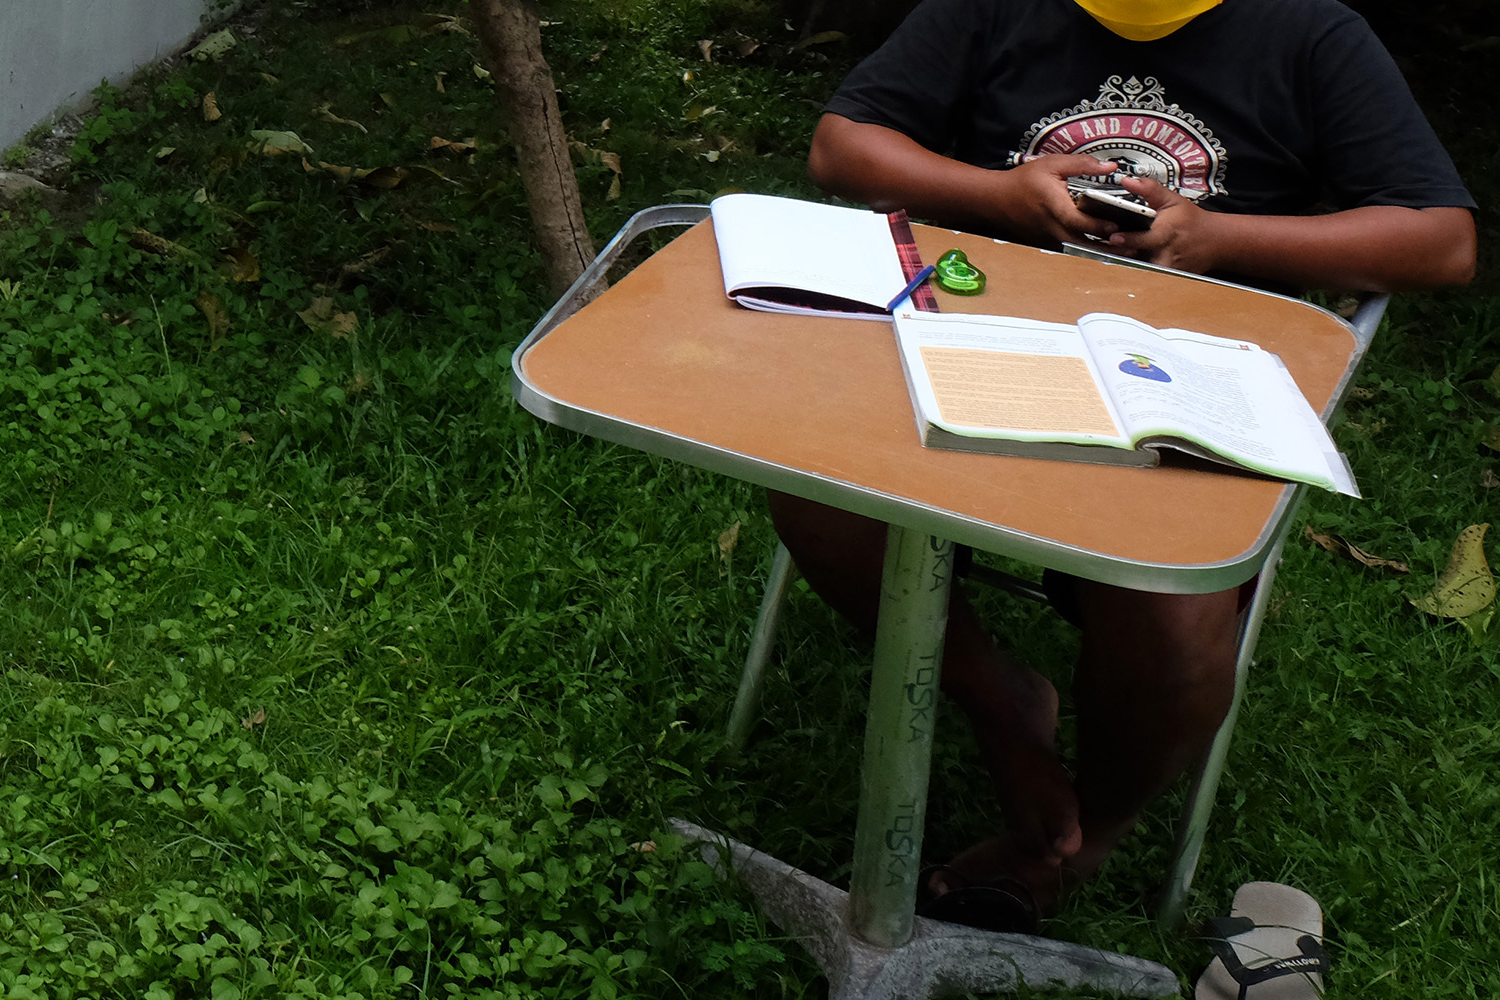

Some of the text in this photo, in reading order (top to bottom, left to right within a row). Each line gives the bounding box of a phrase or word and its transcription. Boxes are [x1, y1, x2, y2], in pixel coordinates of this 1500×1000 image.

[1080, 117, 1121, 139] AND
[929, 535, 950, 592] SKA
[906, 647, 940, 744] TOSKA
[885, 798, 917, 888] TOSKA
